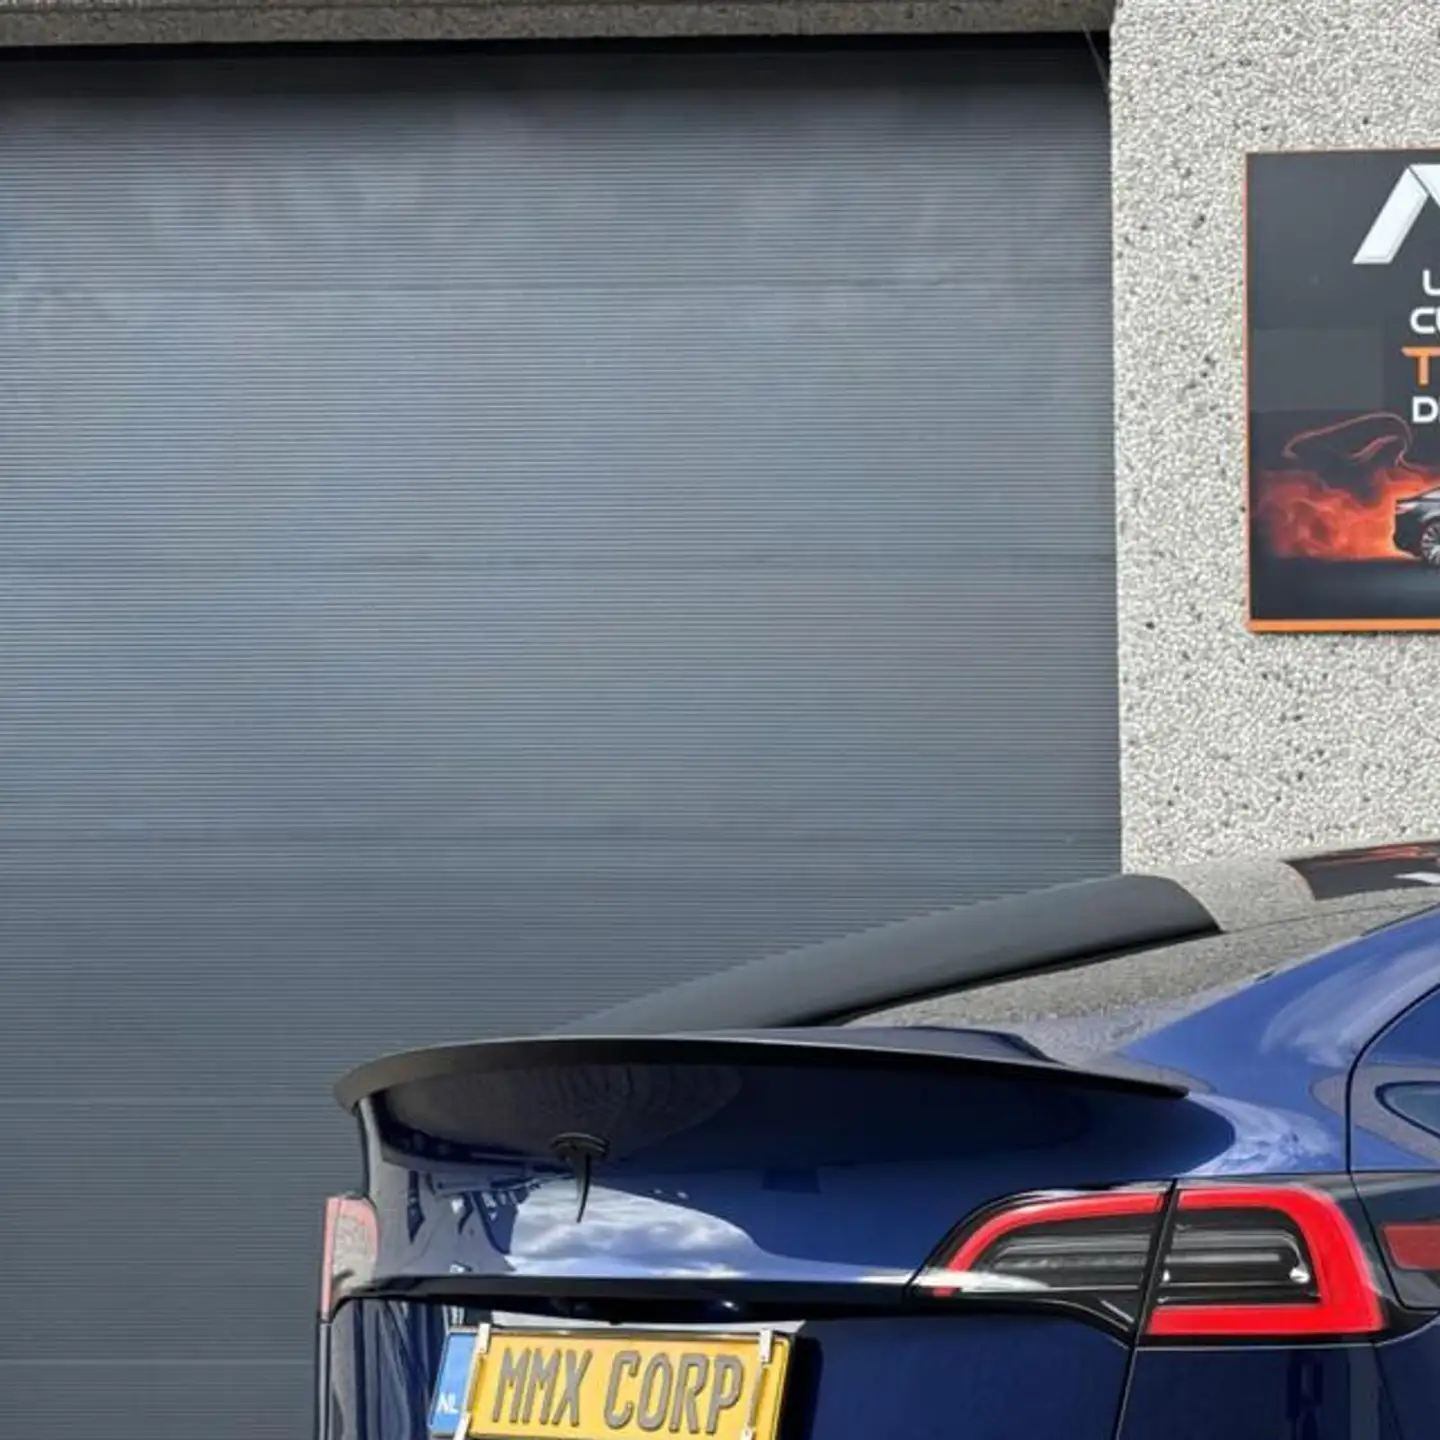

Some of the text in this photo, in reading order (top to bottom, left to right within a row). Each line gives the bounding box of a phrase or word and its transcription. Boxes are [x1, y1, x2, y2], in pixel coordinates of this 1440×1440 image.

[436, 1391, 459, 1415] NL
[492, 1347, 745, 1436] MMX CORP
